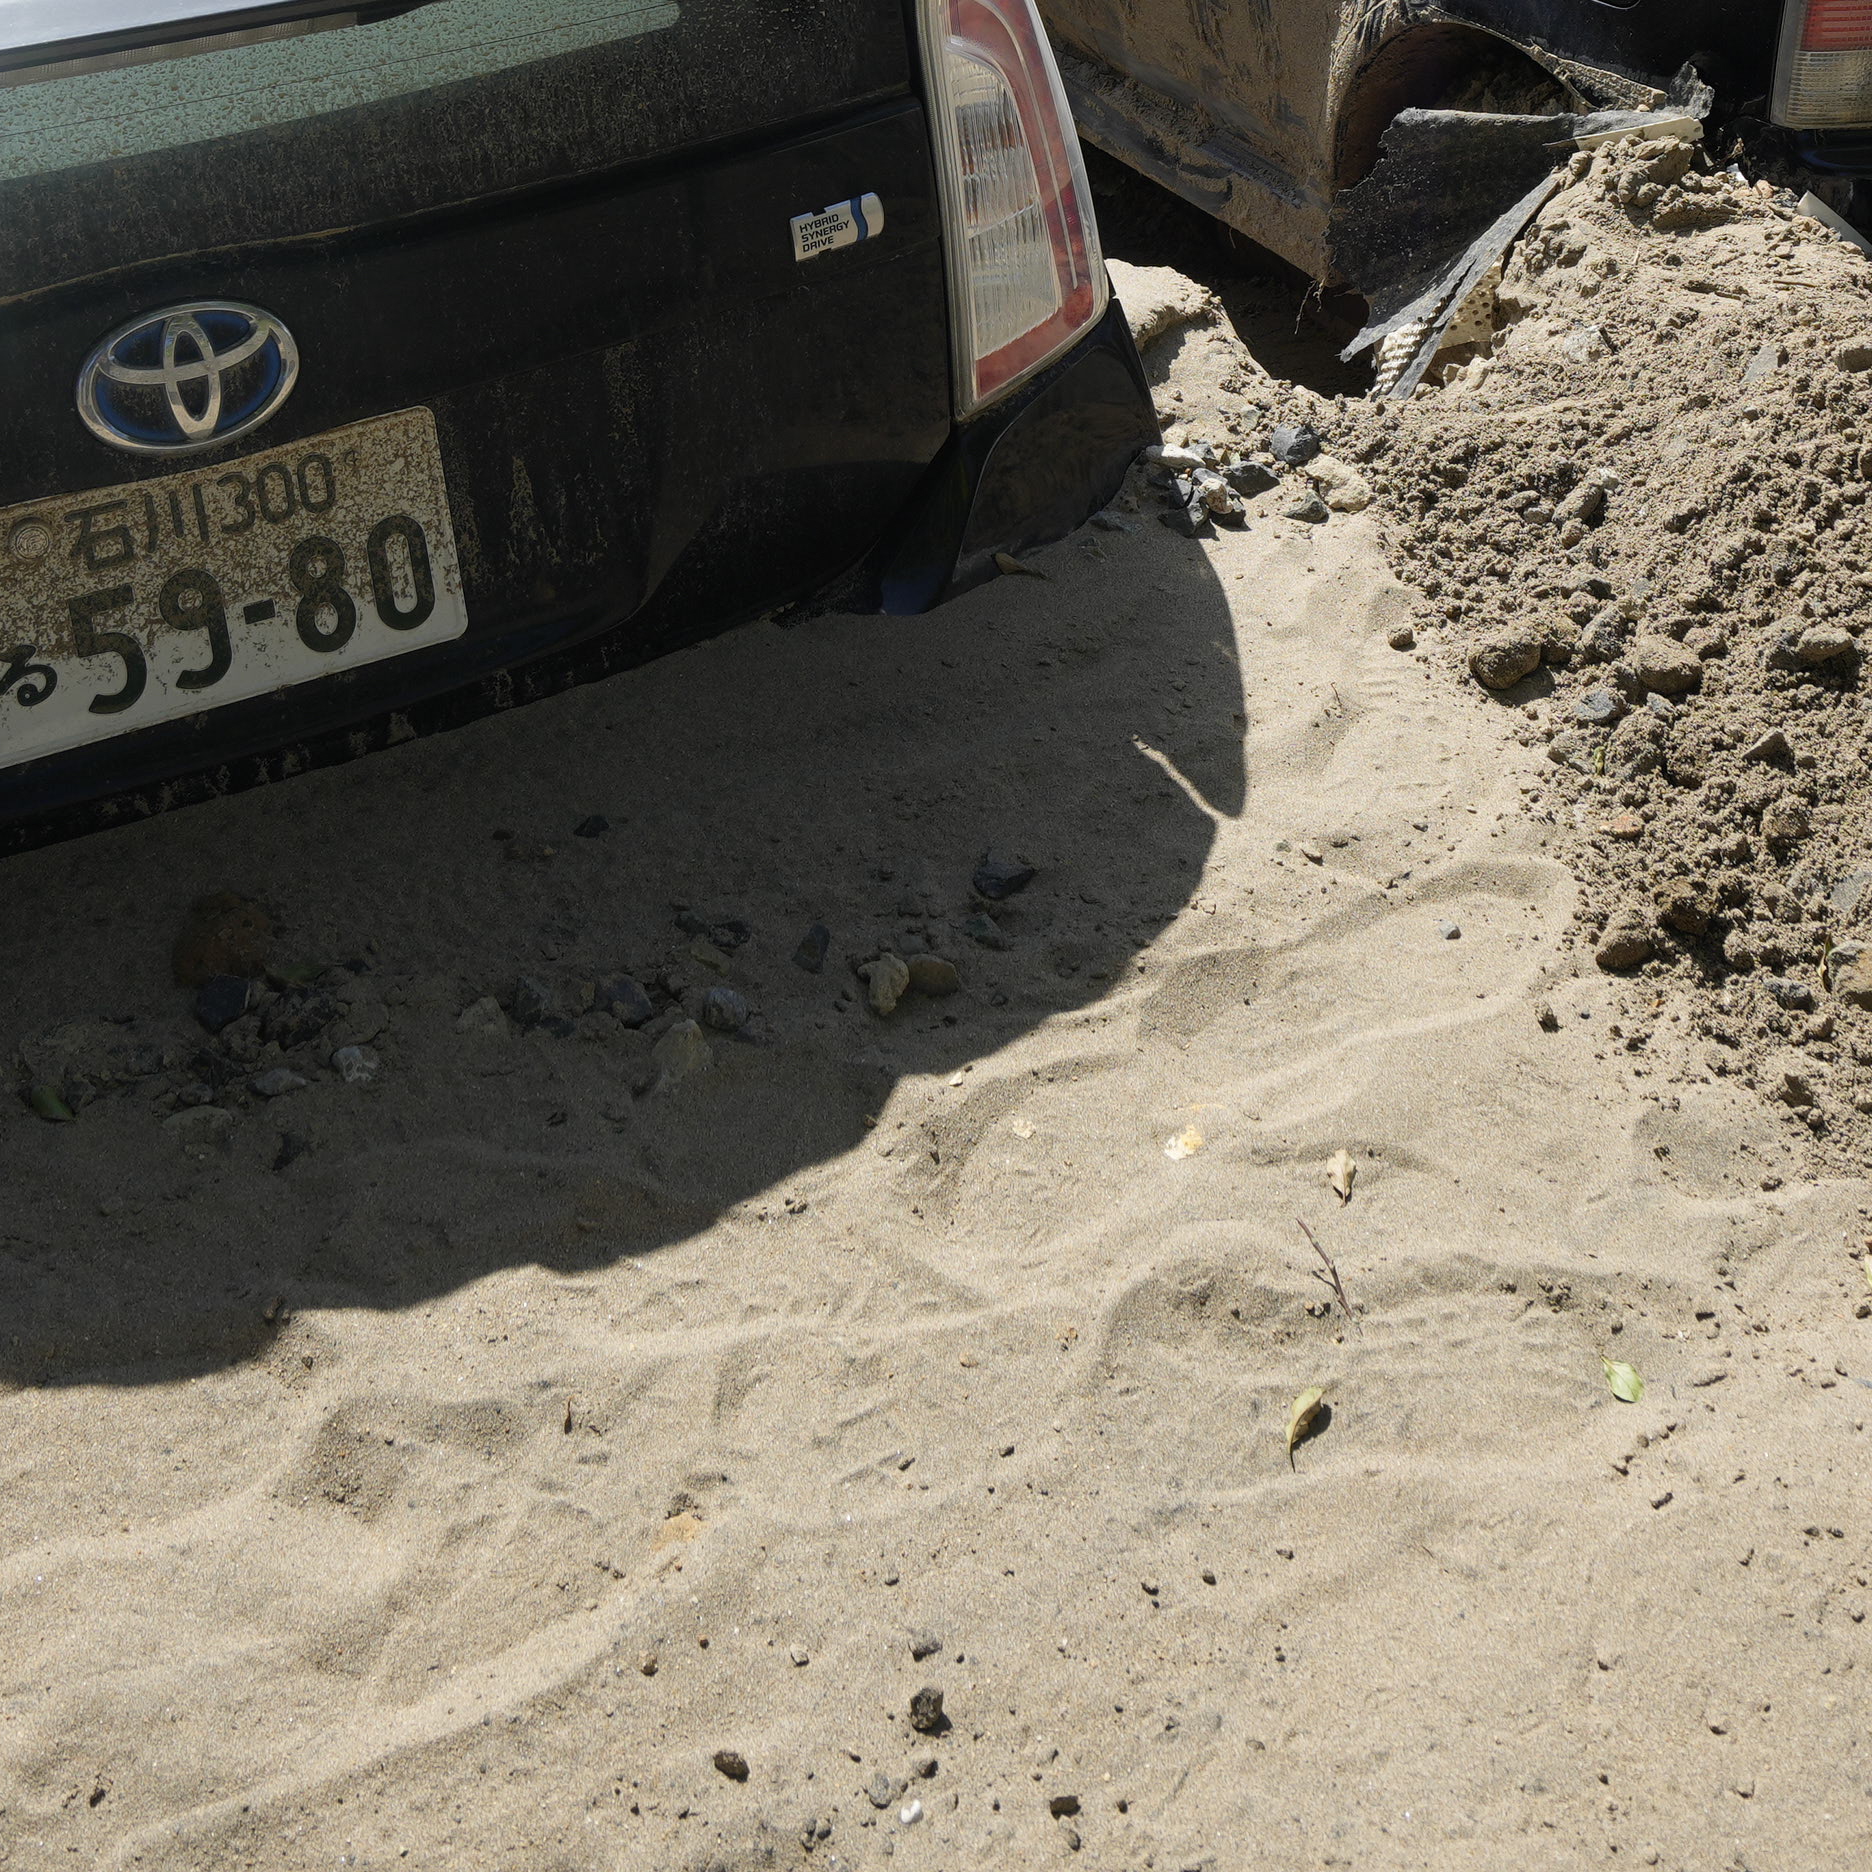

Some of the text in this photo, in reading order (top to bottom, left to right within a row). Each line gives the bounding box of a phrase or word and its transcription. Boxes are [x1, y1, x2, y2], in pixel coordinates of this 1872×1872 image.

[799, 213, 839, 233] HYBRID
[801, 220, 850, 243] SYNERGY
[802, 235, 834, 252] DRIVE
[68, 514, 436, 715] 59-80
